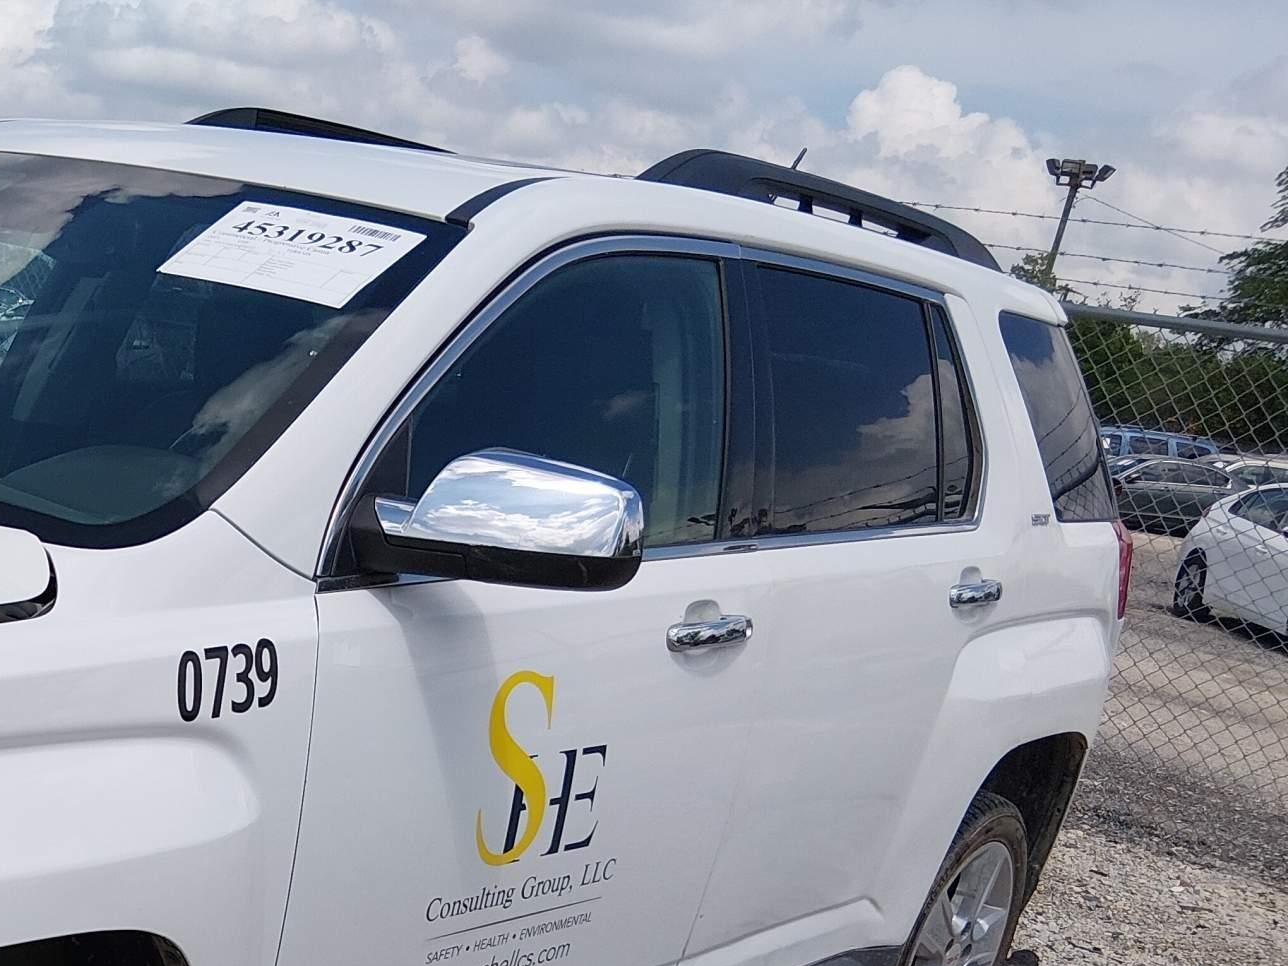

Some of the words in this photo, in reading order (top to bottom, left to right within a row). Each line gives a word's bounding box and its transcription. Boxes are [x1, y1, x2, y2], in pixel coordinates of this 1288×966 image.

[232, 220, 384, 257] 45319287
[178, 639, 279, 722] 0739
[425, 884, 516, 922] Consulting
[521, 873, 573, 900] Group,
[579, 858, 617, 887] LLC
[425, 944, 463, 965] SAFETY
[473, 933, 510, 952] HEALTH
[519, 911, 592, 941] ENVIRONMENTAL
